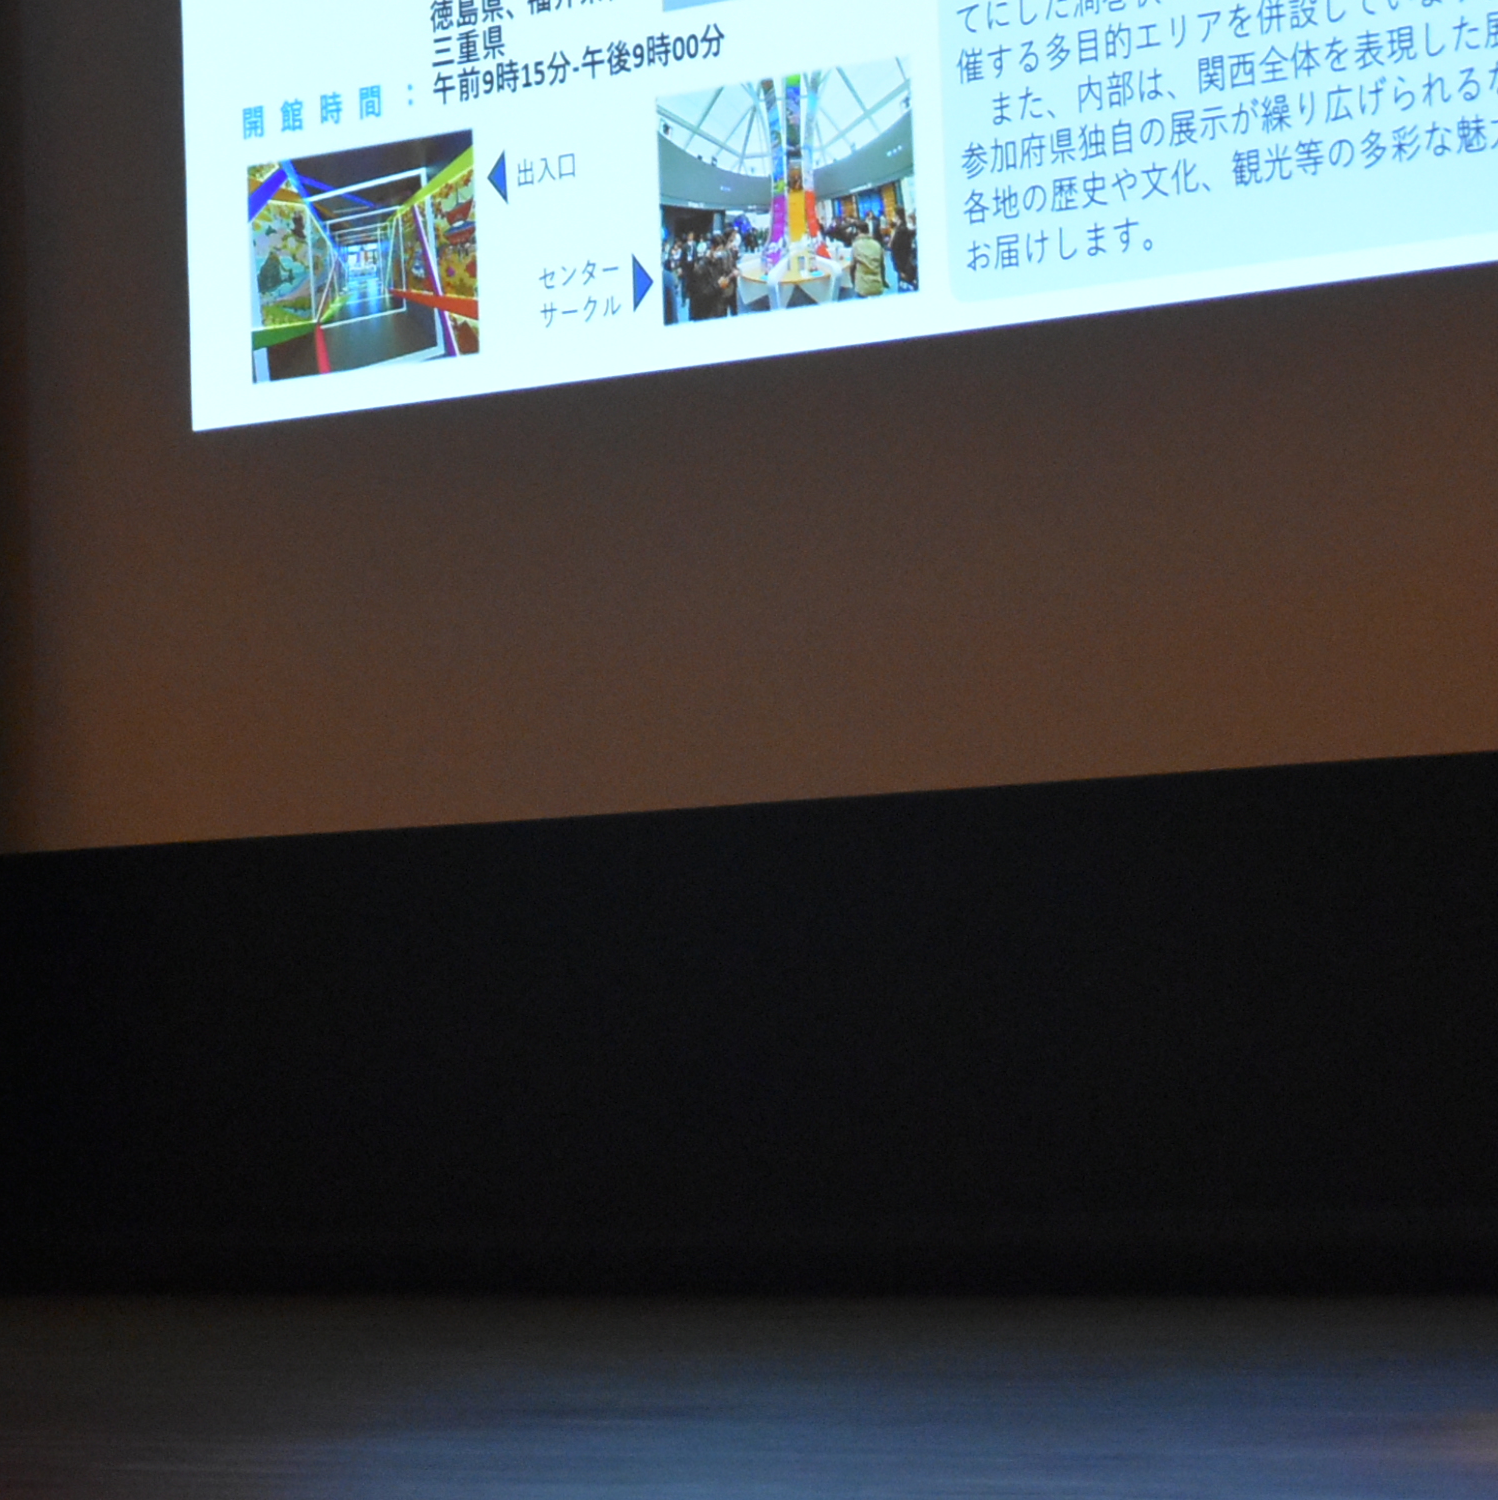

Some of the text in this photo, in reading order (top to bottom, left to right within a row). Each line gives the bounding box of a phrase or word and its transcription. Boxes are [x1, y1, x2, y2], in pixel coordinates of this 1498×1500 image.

[431, 23, 506, 68] 三重県
[431, 23, 726, 106] 午前9時15分-午後9時00分
[516, 152, 577, 188] 出入口
[966, 217, 1154, 272] お届けします。
[537, 257, 620, 291] センター
[539, 295, 623, 329] サークル
